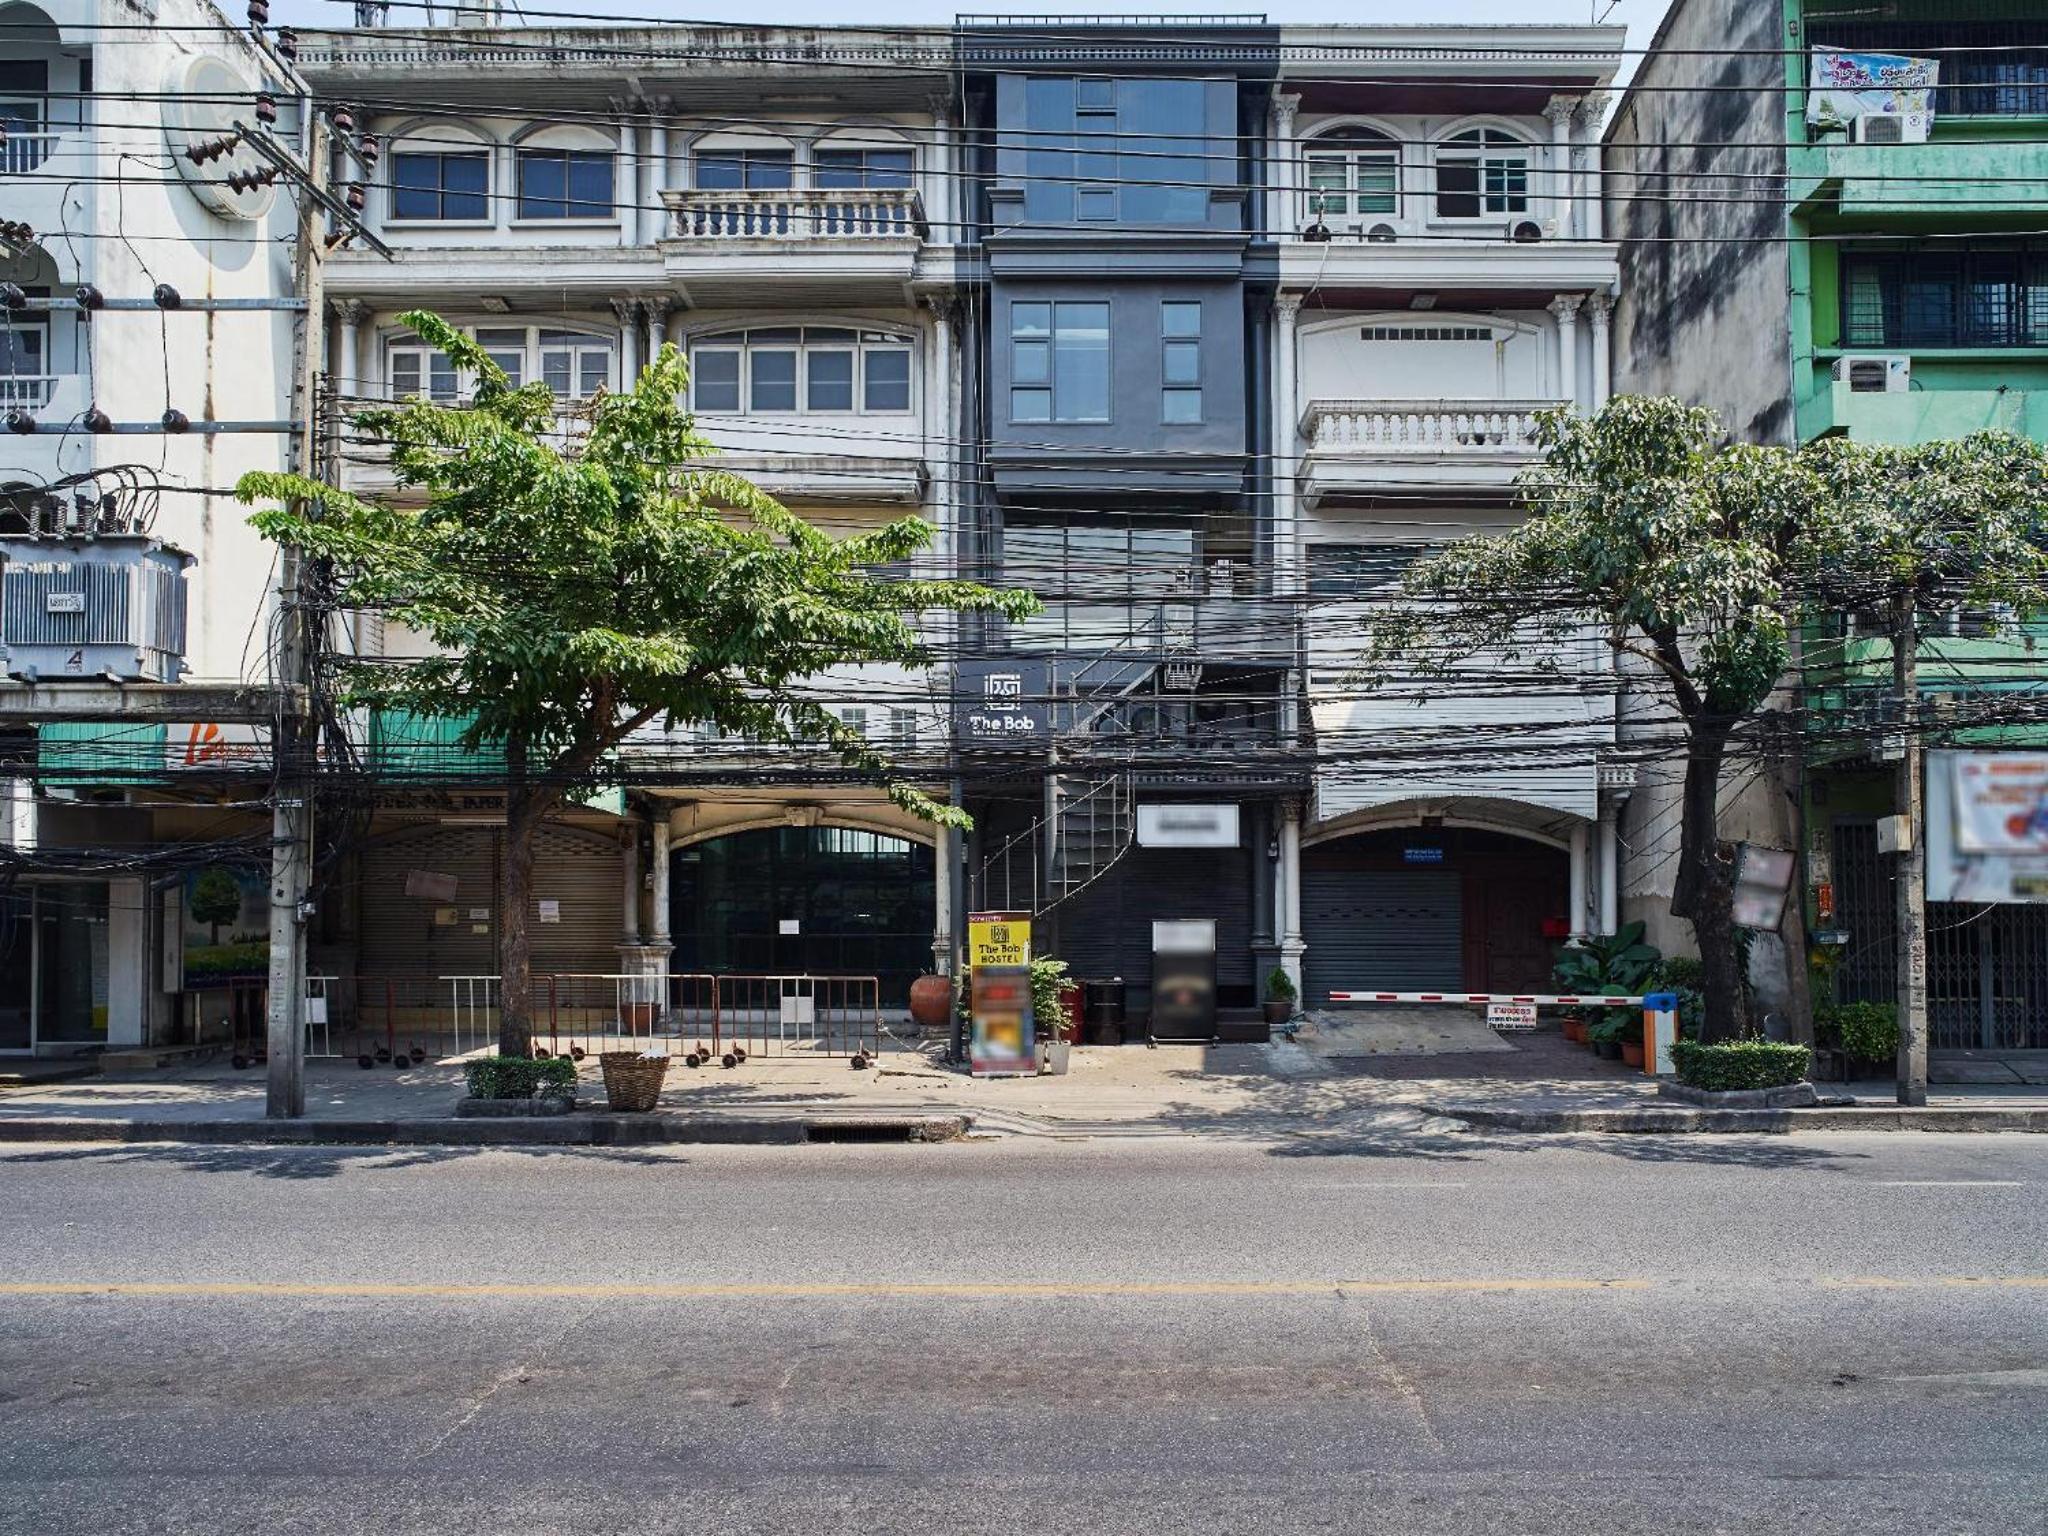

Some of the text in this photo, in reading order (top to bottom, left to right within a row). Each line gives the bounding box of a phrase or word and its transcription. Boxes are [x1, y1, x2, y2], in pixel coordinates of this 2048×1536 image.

[969, 714, 1034, 730] The Bob
[979, 943, 1021, 954] The Bob
[981, 954, 1019, 964] HOSTEL
